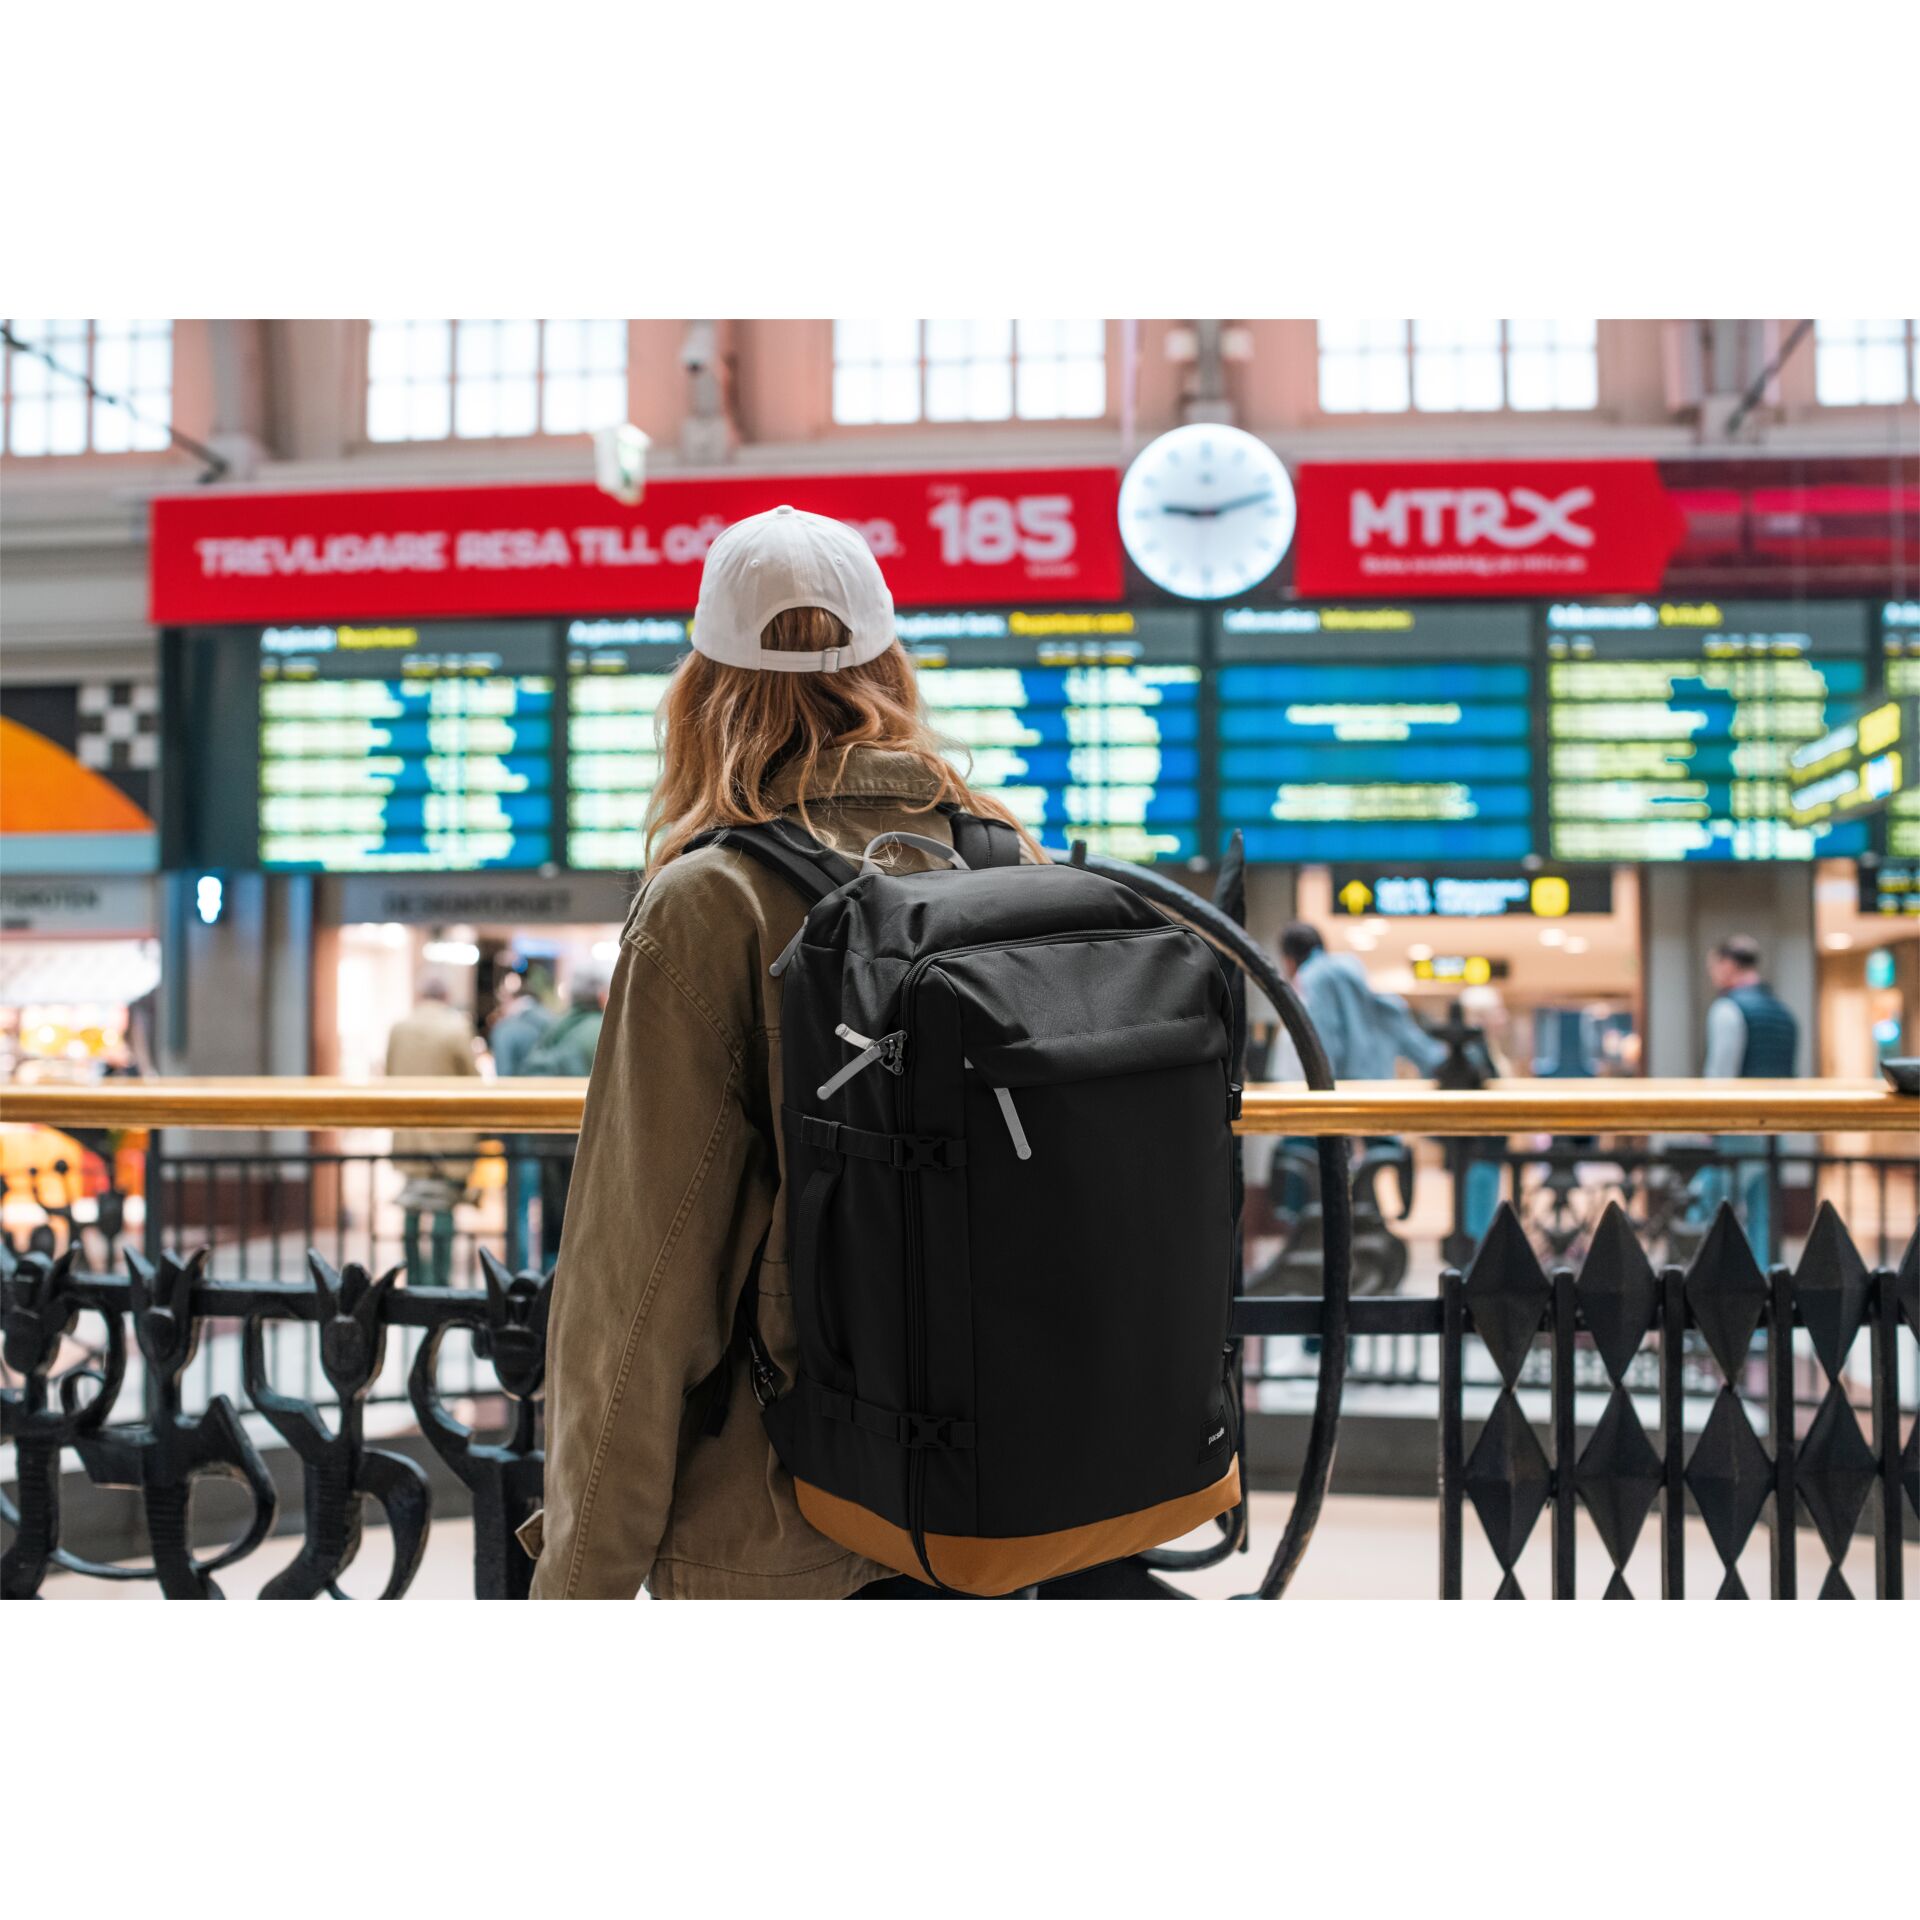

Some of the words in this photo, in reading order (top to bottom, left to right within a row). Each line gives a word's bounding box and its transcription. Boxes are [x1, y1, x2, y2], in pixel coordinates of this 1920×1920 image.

[457, 530, 569, 569] RESA
[573, 526, 661, 566] TILL
[927, 495, 1077, 566] 185
[1350, 486, 1596, 549] MTRX
